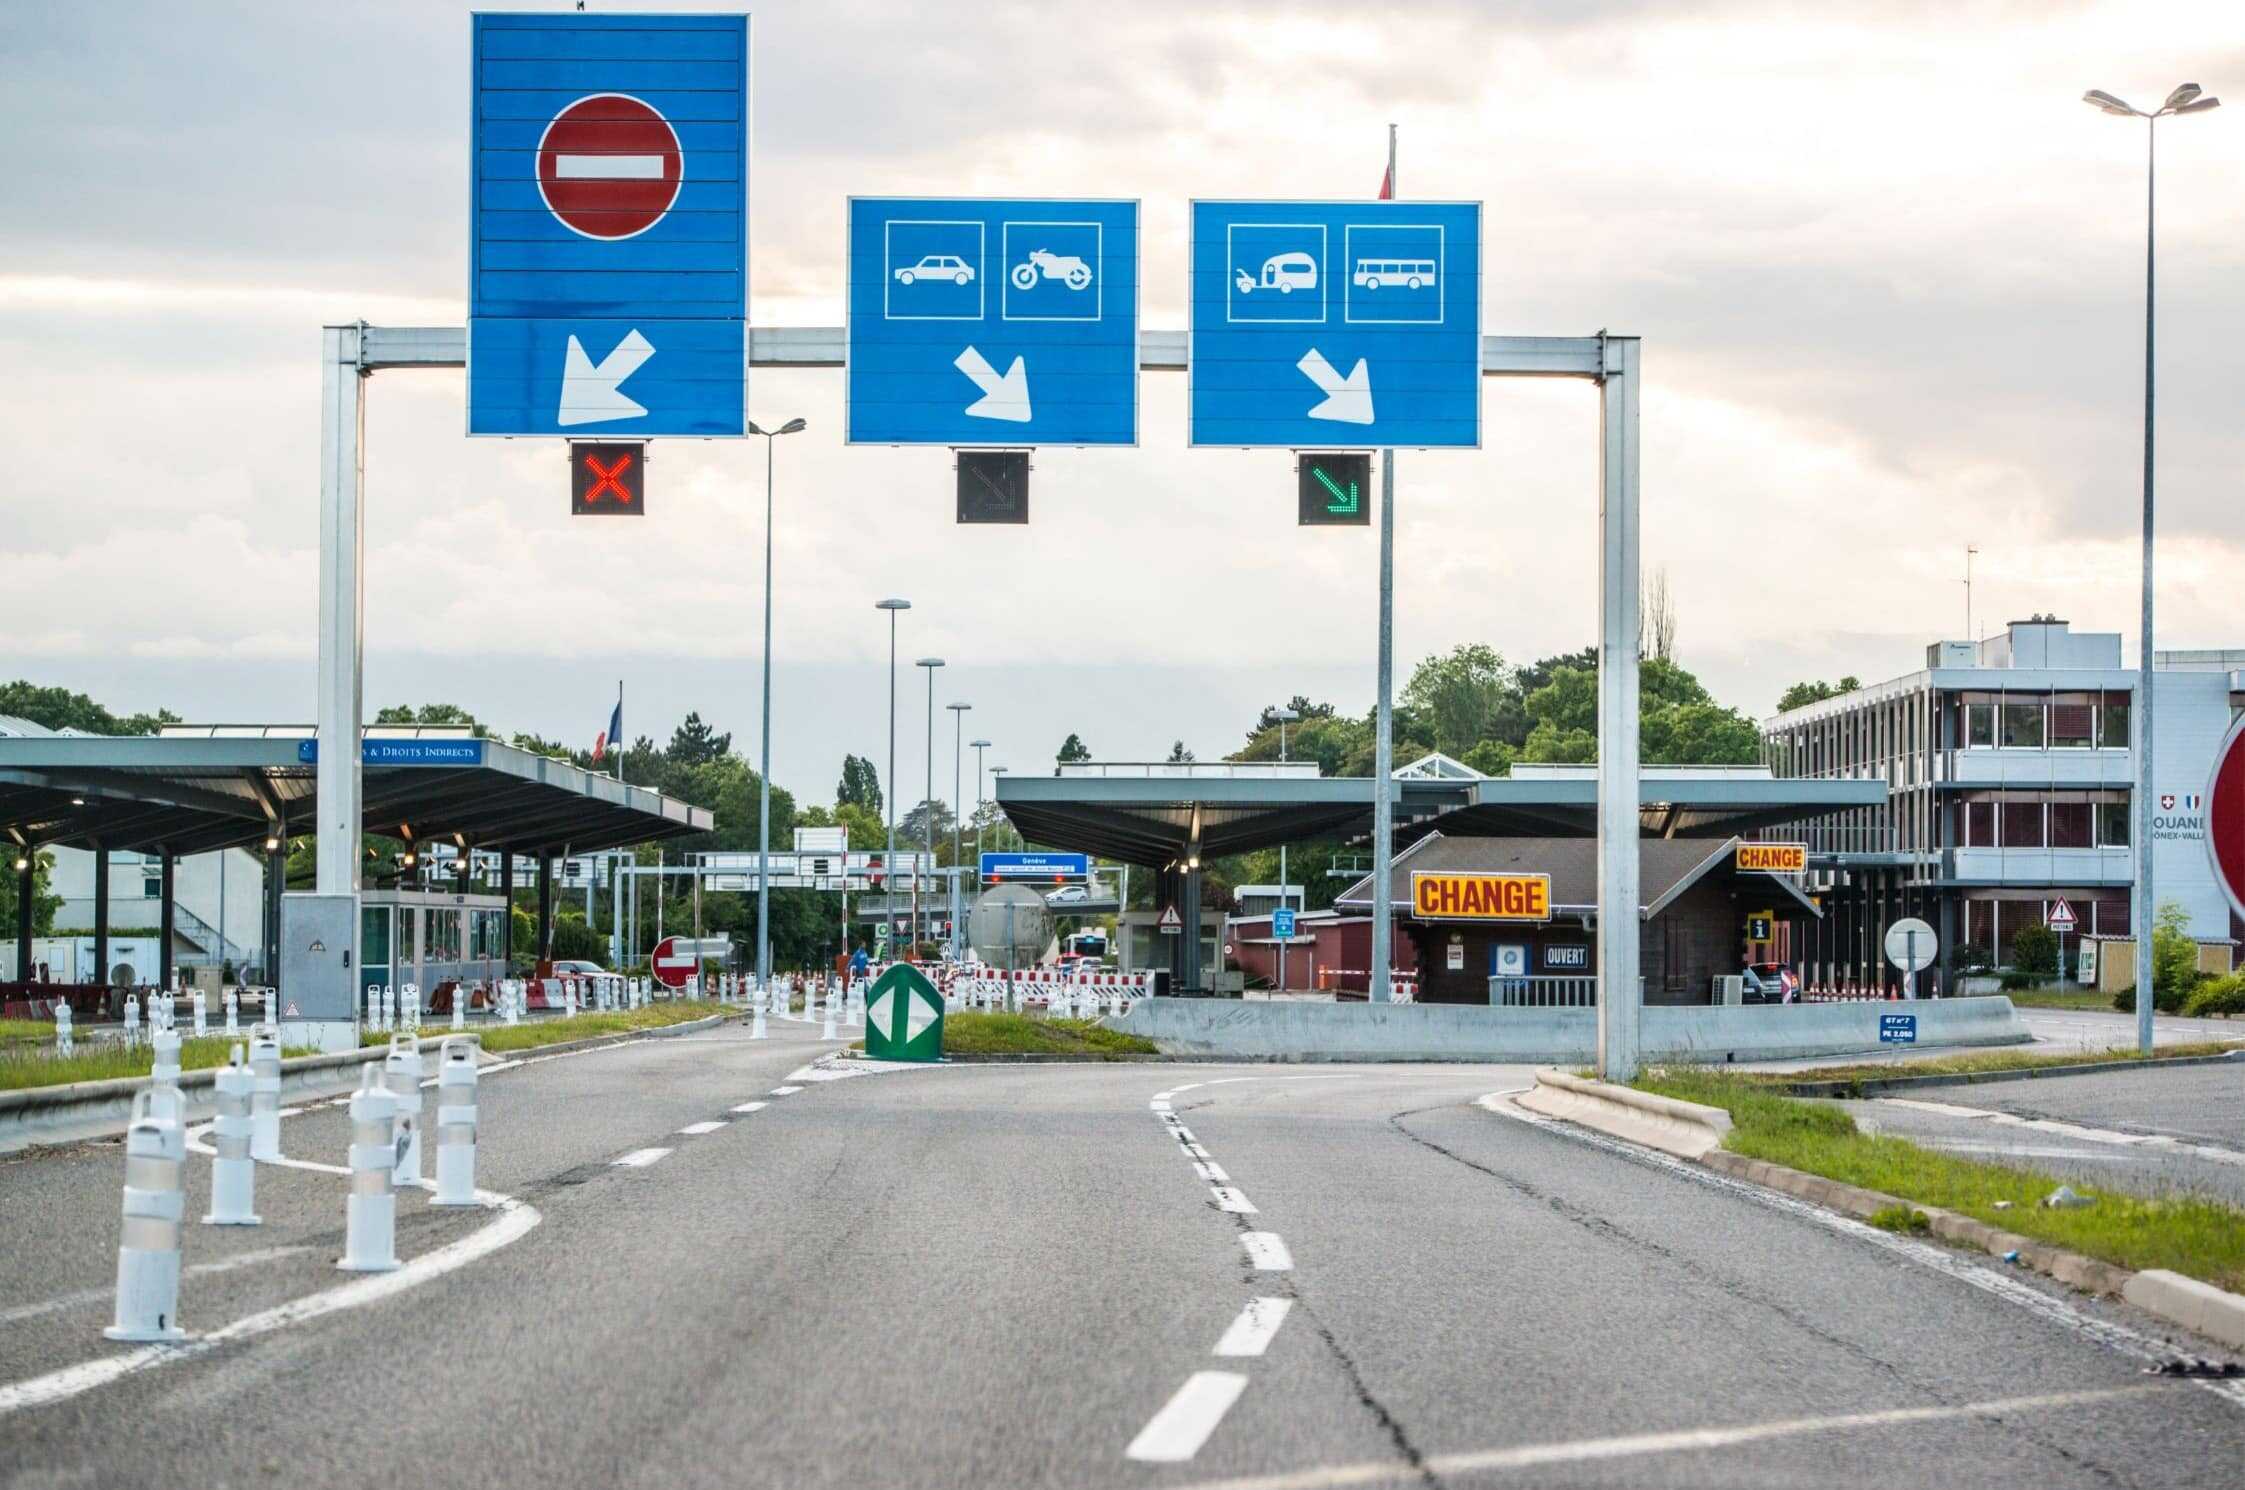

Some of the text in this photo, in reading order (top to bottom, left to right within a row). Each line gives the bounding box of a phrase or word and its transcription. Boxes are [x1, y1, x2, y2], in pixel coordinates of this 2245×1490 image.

[370, 746, 378, 757] &
[382, 746, 421, 757] DROITS
[425, 746, 474, 757] INDIRECTS
[1740, 848, 1802, 867] CHANGE
[1419, 878, 1543, 915] CHANGE
[1547, 948, 1585, 965] OUVERT
